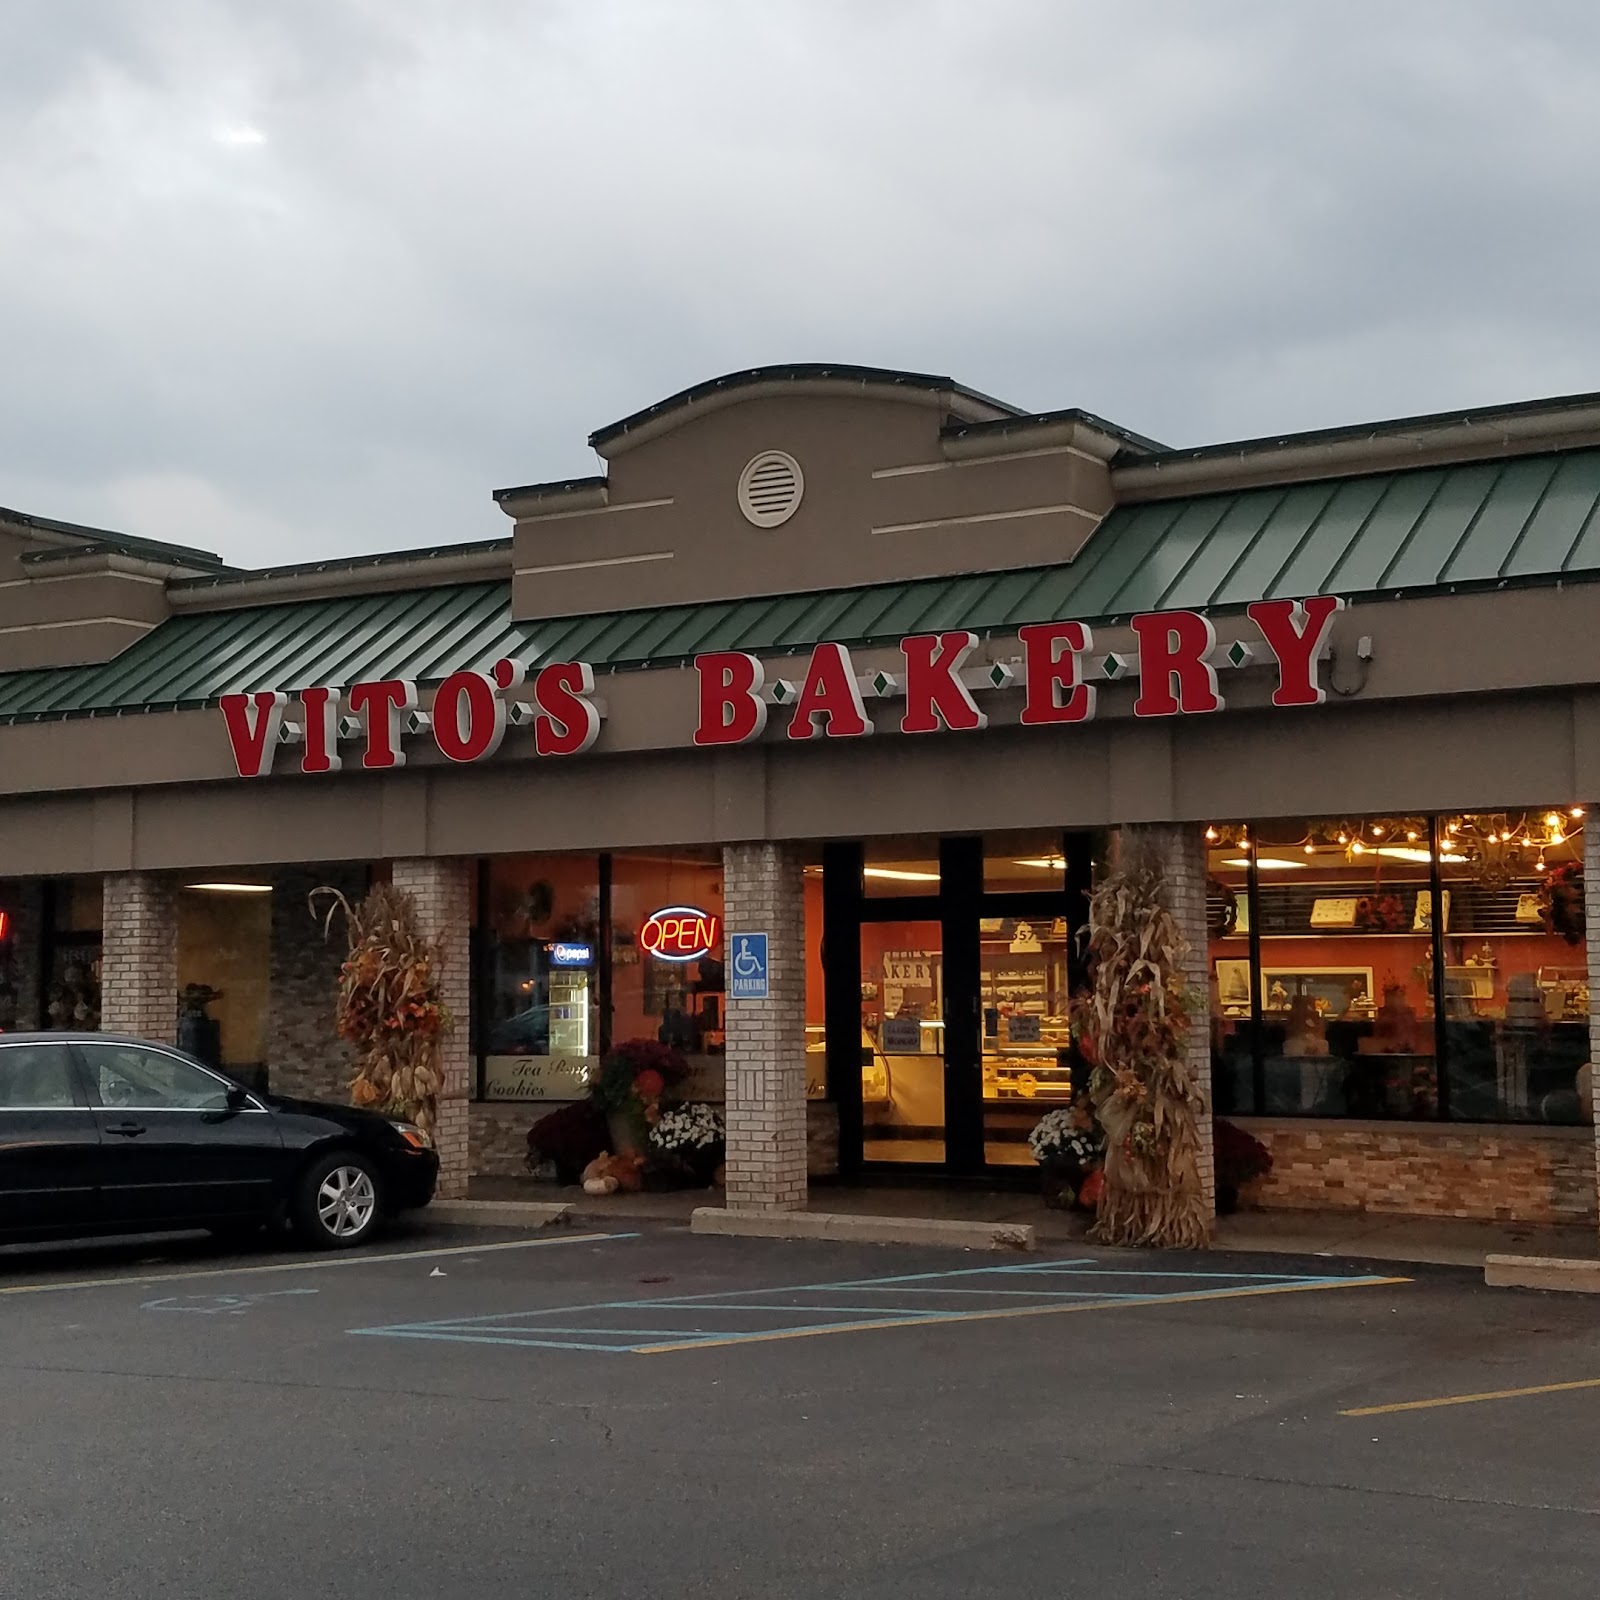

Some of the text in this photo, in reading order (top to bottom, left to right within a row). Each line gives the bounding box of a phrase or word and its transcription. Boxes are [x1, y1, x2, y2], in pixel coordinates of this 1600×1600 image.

[220, 597, 1346, 777] VITO'S BAKERY
[641, 917, 716, 950] OPEN
[734, 978, 765, 991] PARKING
[512, 1059, 542, 1076] Tea
[487, 1079, 545, 1096] Cookies
